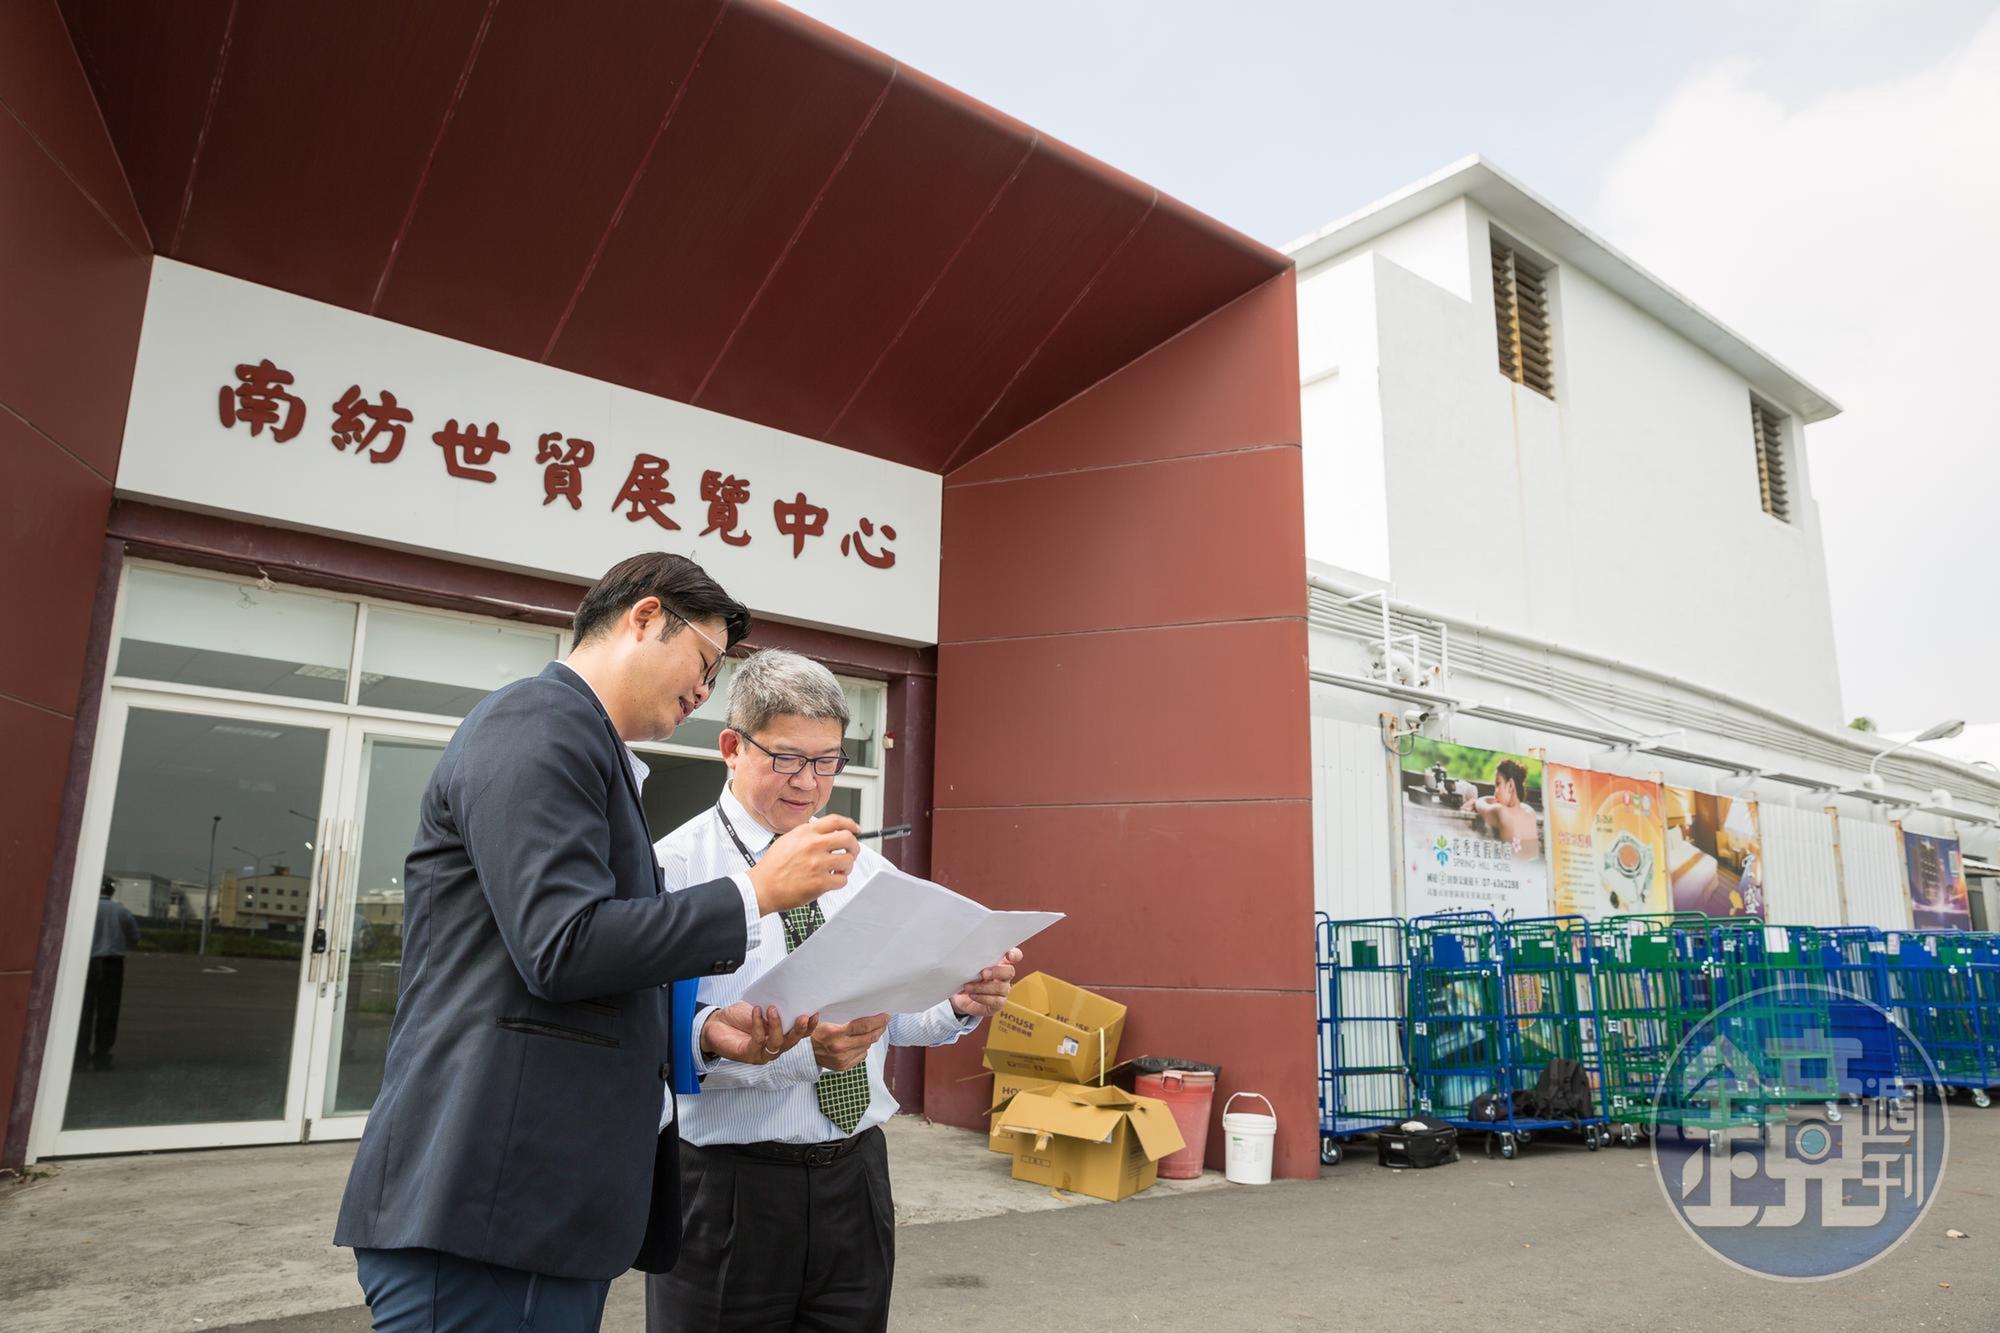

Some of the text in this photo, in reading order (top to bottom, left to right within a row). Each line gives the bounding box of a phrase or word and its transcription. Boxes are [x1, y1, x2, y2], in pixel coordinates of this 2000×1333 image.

[218, 358, 897, 570] 南紡世貿展覽中心
[1453, 858, 1476, 869] SPRING
[1493, 863, 1512, 873] HOTEL
[1000, 1011, 1035, 1031] HOUSE
